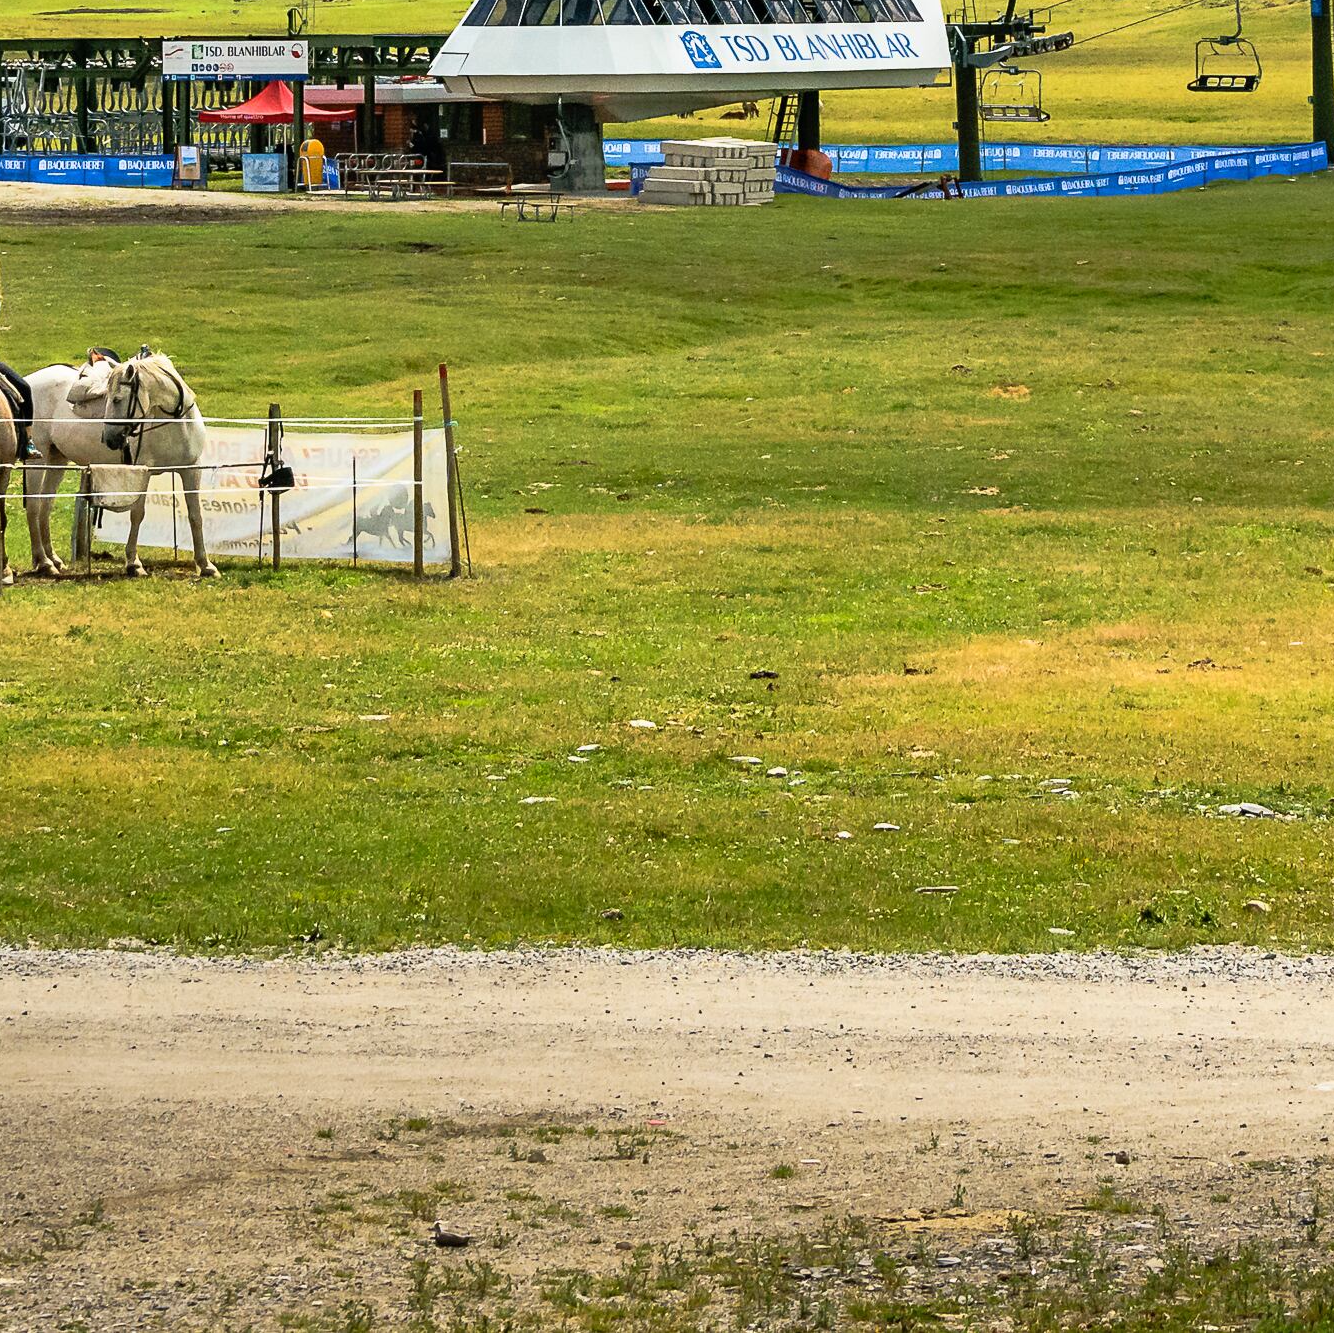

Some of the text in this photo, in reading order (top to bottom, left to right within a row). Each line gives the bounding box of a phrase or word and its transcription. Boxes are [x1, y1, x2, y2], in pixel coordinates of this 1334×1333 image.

[227, 45, 286, 57] BLANHIBLAR
[720, 32, 920, 62] TSD BLANHIBLAR
